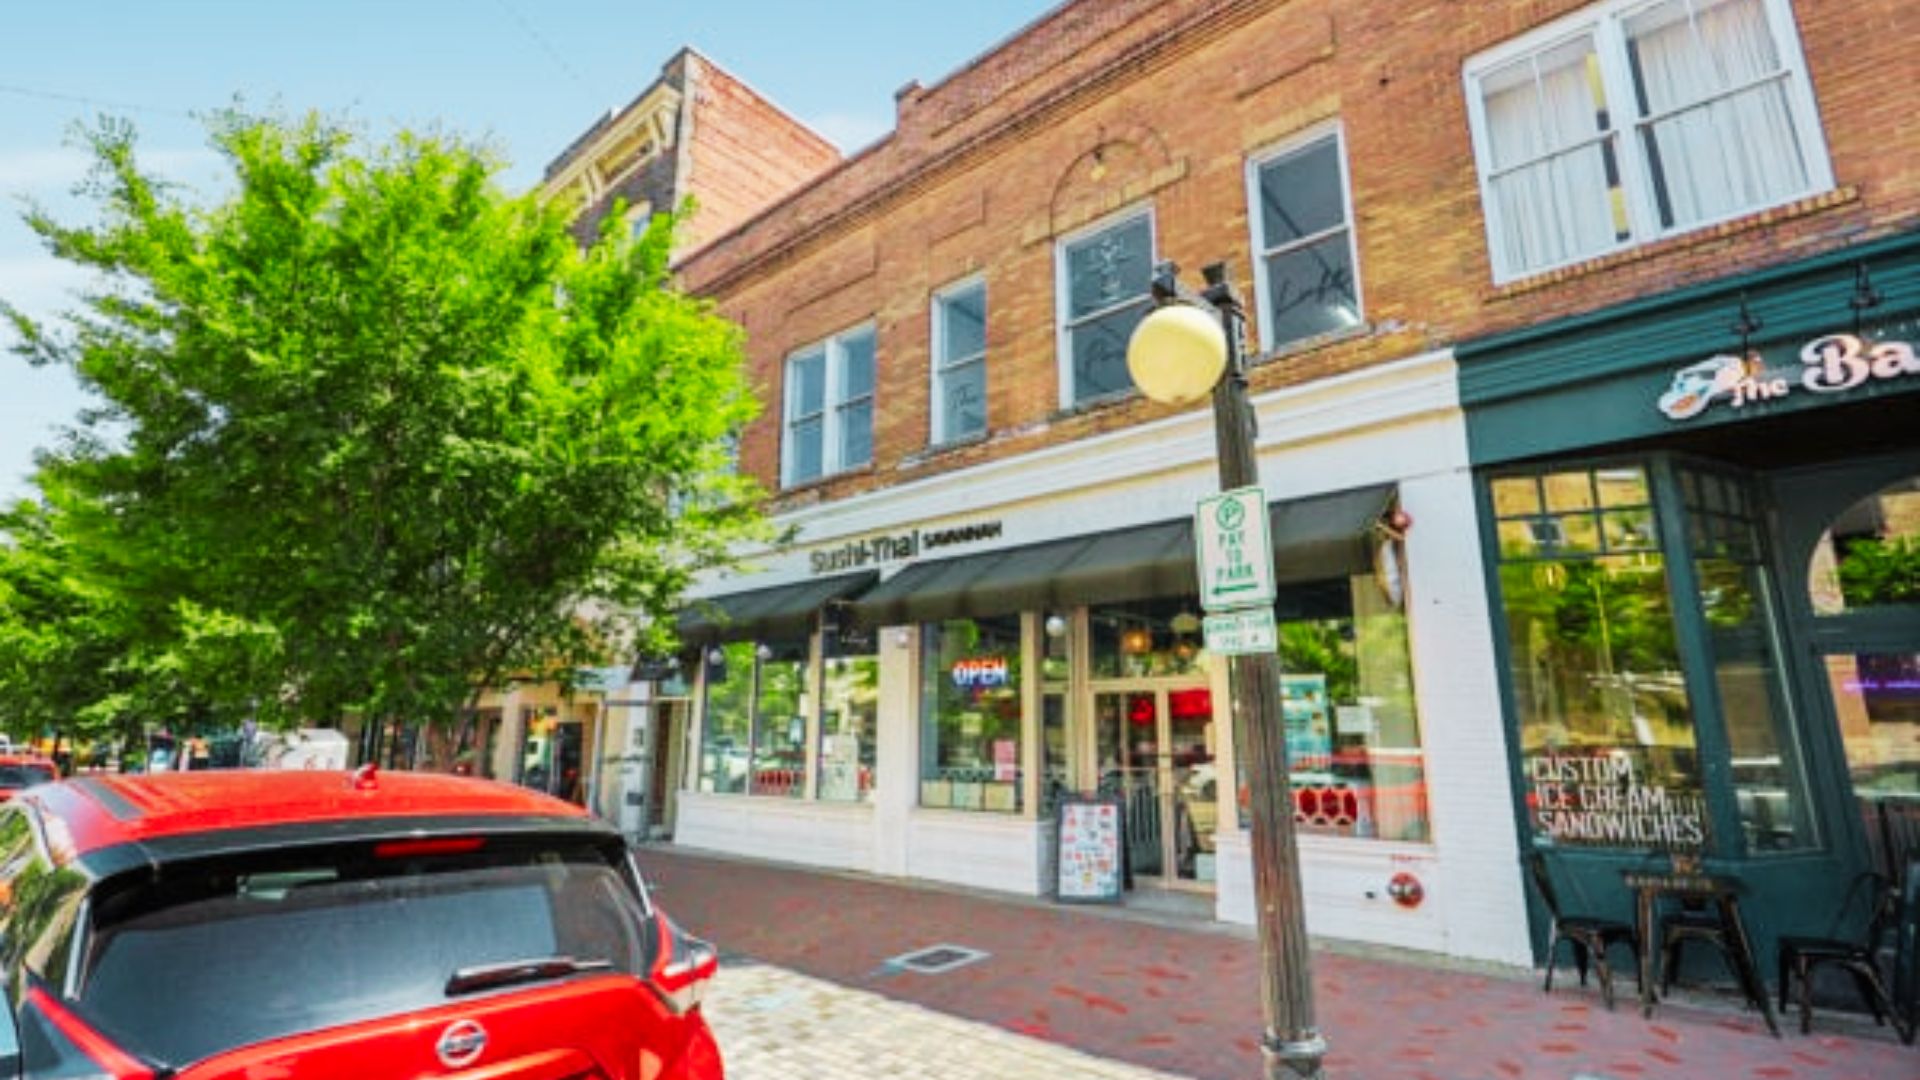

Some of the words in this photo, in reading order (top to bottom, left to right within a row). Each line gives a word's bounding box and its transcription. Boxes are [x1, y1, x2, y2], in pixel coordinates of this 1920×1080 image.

[1730, 376, 1789, 407] The
[1216, 563, 1253, 580] PARK
[952, 656, 1008, 686] OPEN
[1532, 755, 1634, 782] CUSTOM
[1535, 782, 1573, 810] ICE
[1579, 784, 1667, 815] CREAM
[1537, 811, 1704, 845] SANDWICHES
